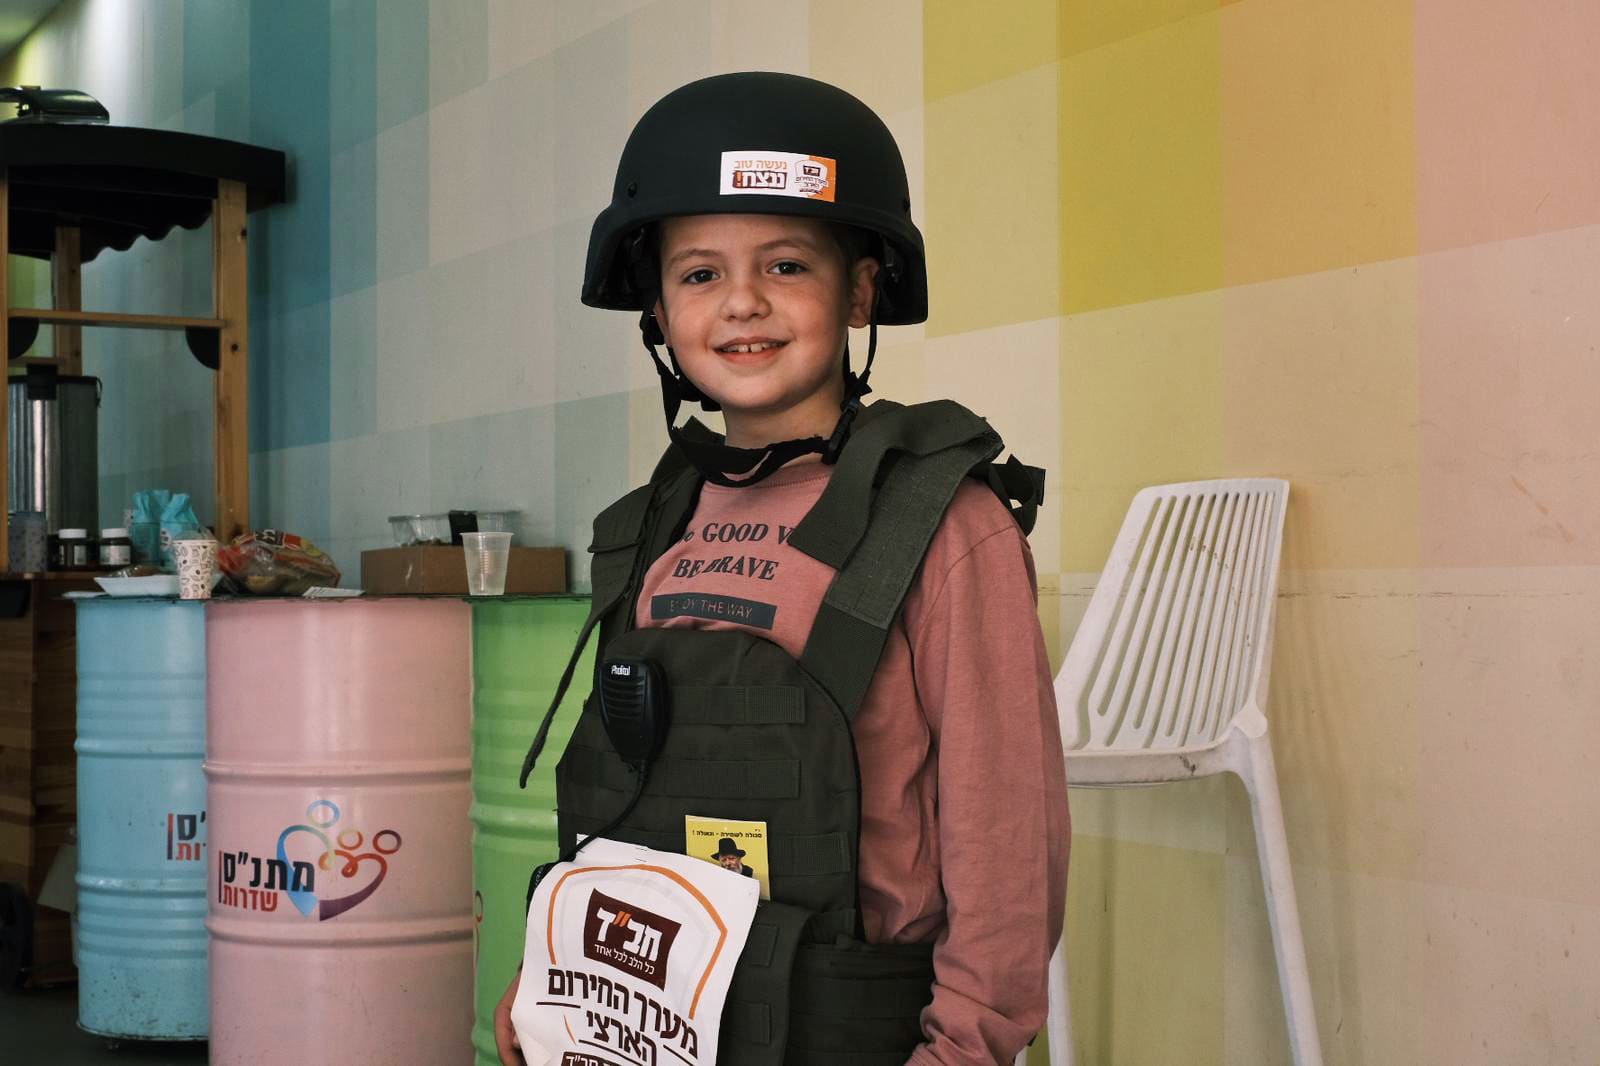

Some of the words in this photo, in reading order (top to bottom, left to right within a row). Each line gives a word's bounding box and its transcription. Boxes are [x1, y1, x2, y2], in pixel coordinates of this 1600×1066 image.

[734, 160, 753, 169] טוב
[756, 160, 787, 169] נעשה
[702, 523, 769, 543] GOOD
[672, 559, 704, 578] BE
[702, 556, 779, 580] BRAVE
[701, 600, 723, 614] THE
[727, 603, 752, 618] WAY
[223, 851, 315, 893] מתנ"ס
[223, 884, 278, 912] שדרות
[596, 907, 662, 962] חב"ד
[594, 944, 612, 957] אחד
[613, 948, 628, 963] לכל
[628, 956, 643, 971] הלב
[644, 961, 655, 975] כל
[548, 968, 629, 1014] החירום
[634, 990, 699, 1060] מערך
[586, 1010, 657, 1066] הארצי
